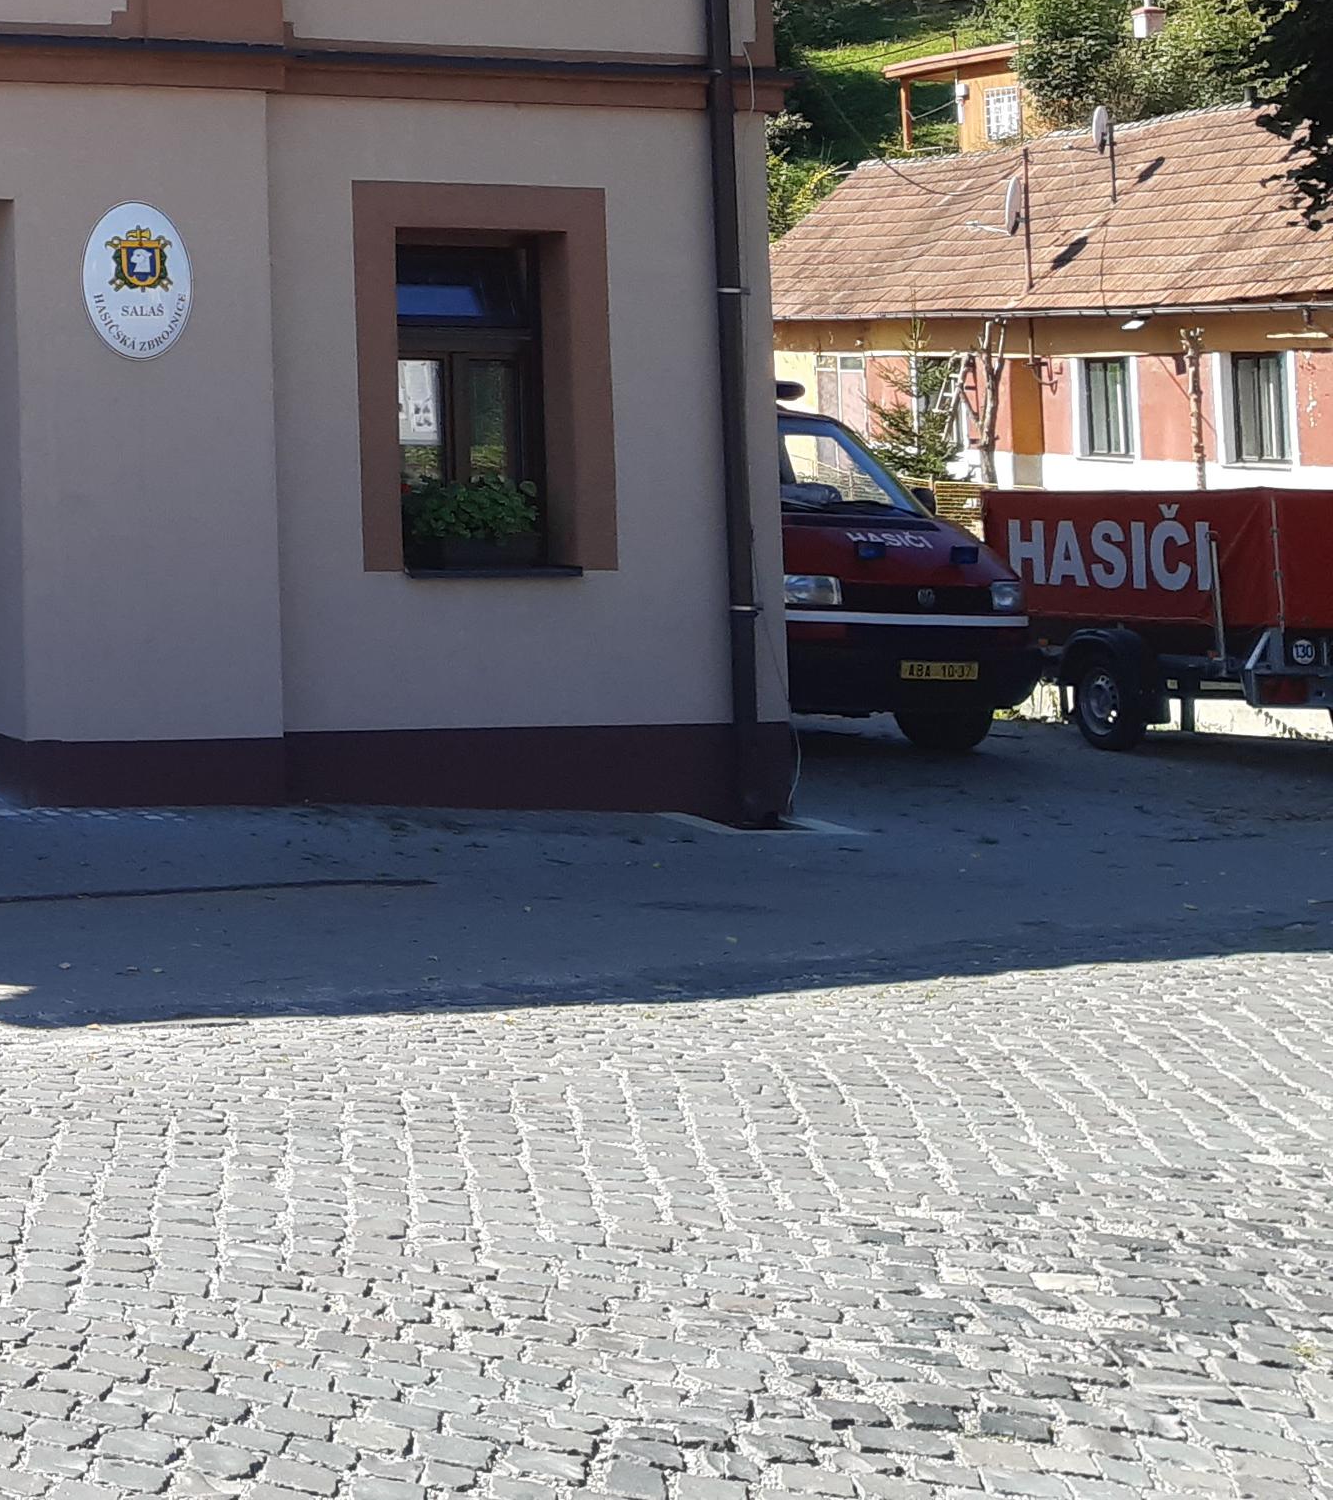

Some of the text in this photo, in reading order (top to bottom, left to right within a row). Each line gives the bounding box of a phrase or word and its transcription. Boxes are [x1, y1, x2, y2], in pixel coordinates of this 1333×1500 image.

[121, 303, 164, 317] SALAŠ
[93, 293, 136, 350] HASIČSKÁ
[845, 531, 933, 549] HASIČI
[1008, 503, 1213, 592] HASIČI
[1295, 644, 1313, 658] 130
